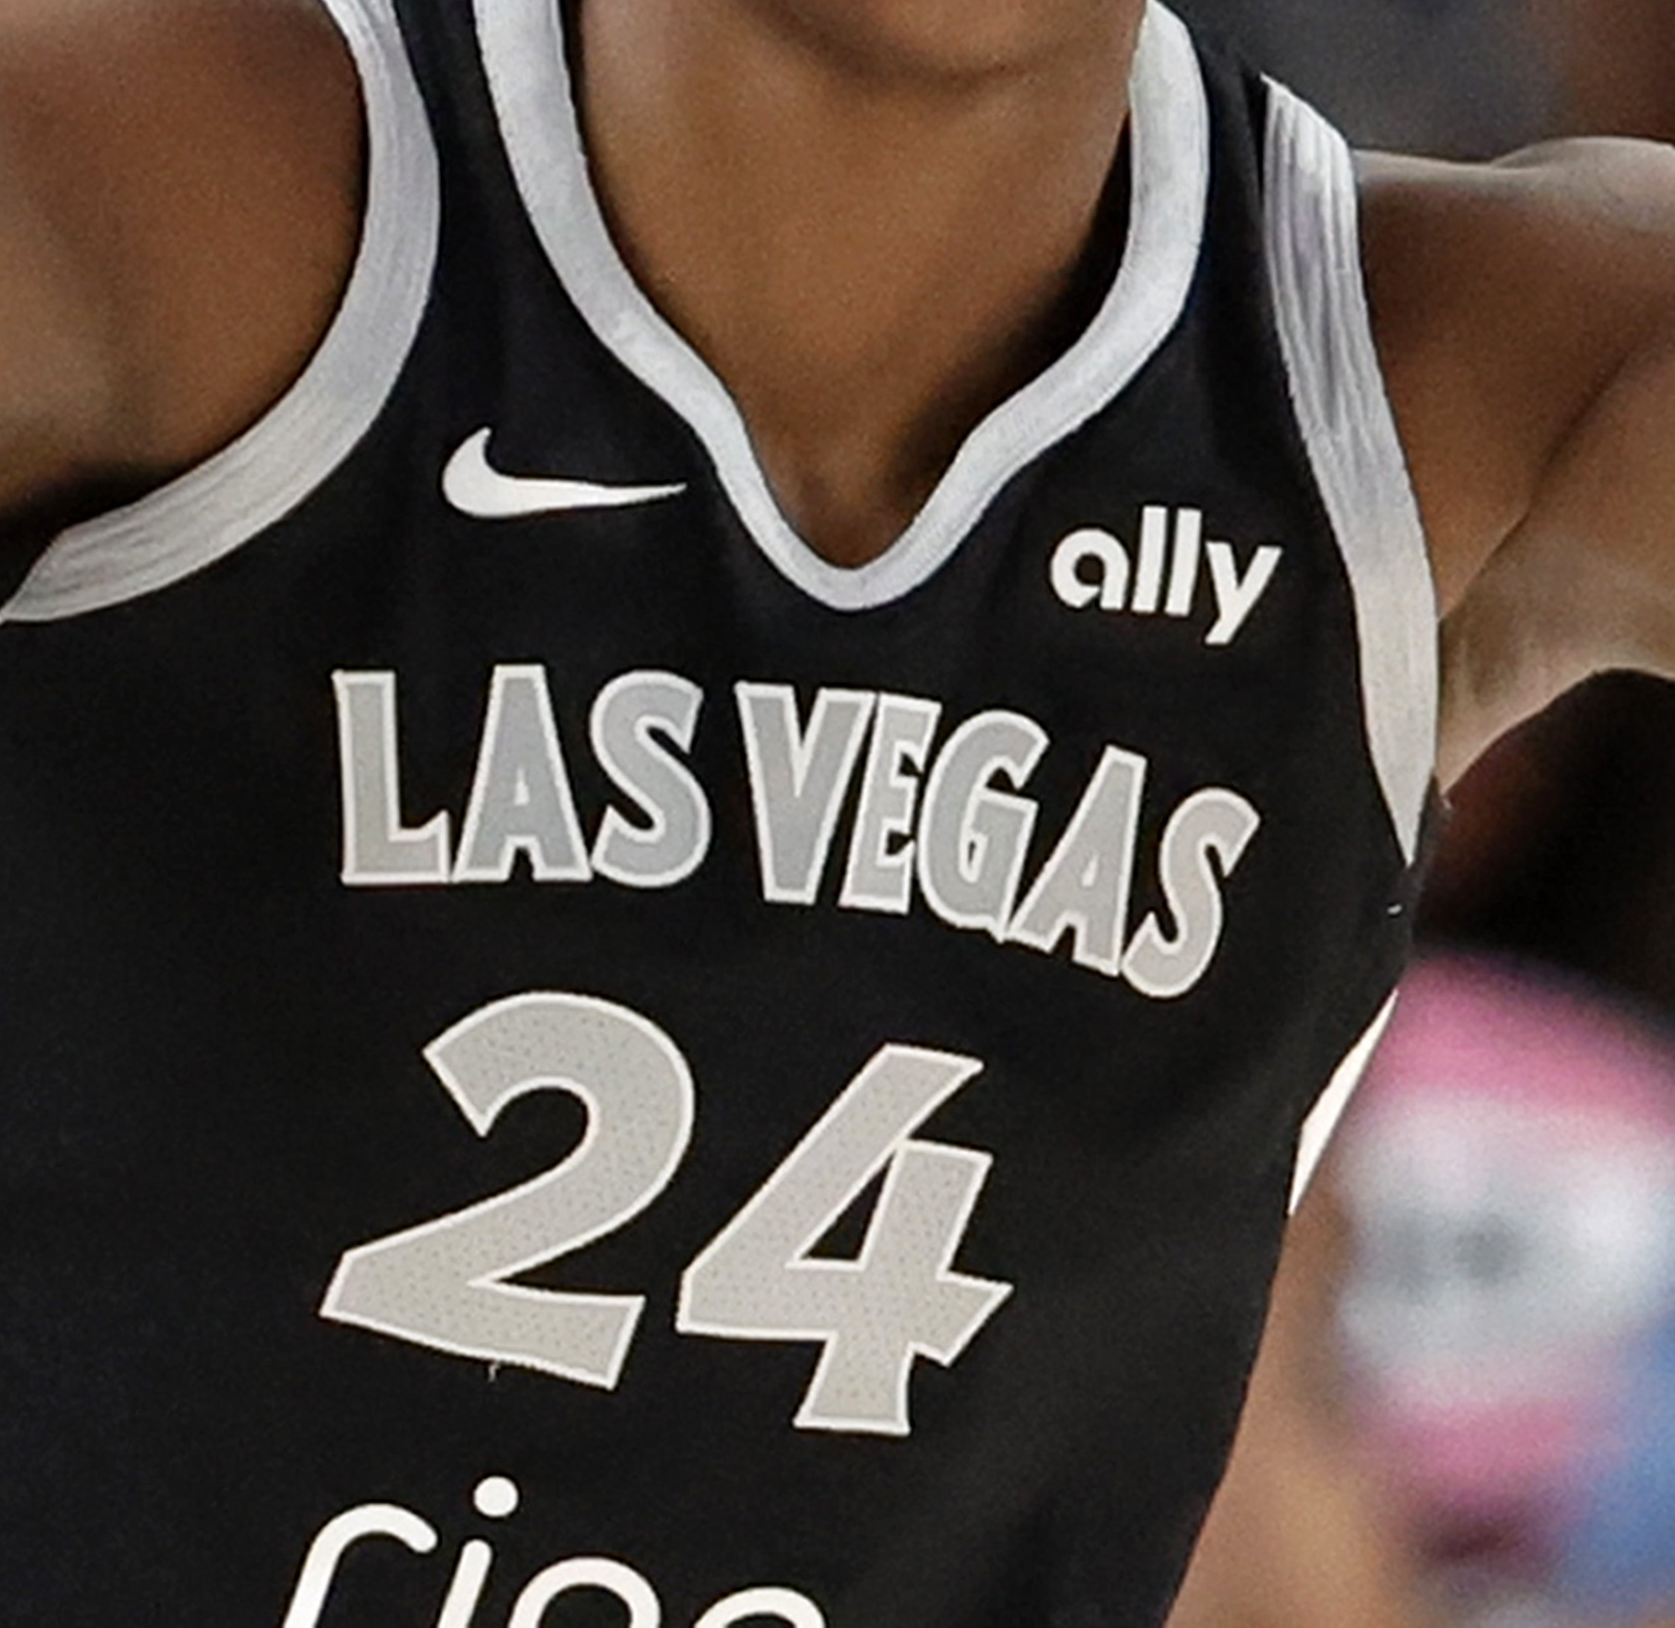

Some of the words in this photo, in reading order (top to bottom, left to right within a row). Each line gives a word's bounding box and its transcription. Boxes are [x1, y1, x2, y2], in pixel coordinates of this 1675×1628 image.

[1050, 505, 1282, 645] ally
[331, 664, 711, 888] LAS
[734, 680, 1260, 998] VEGAS
[319, 990, 1014, 1436] 24
